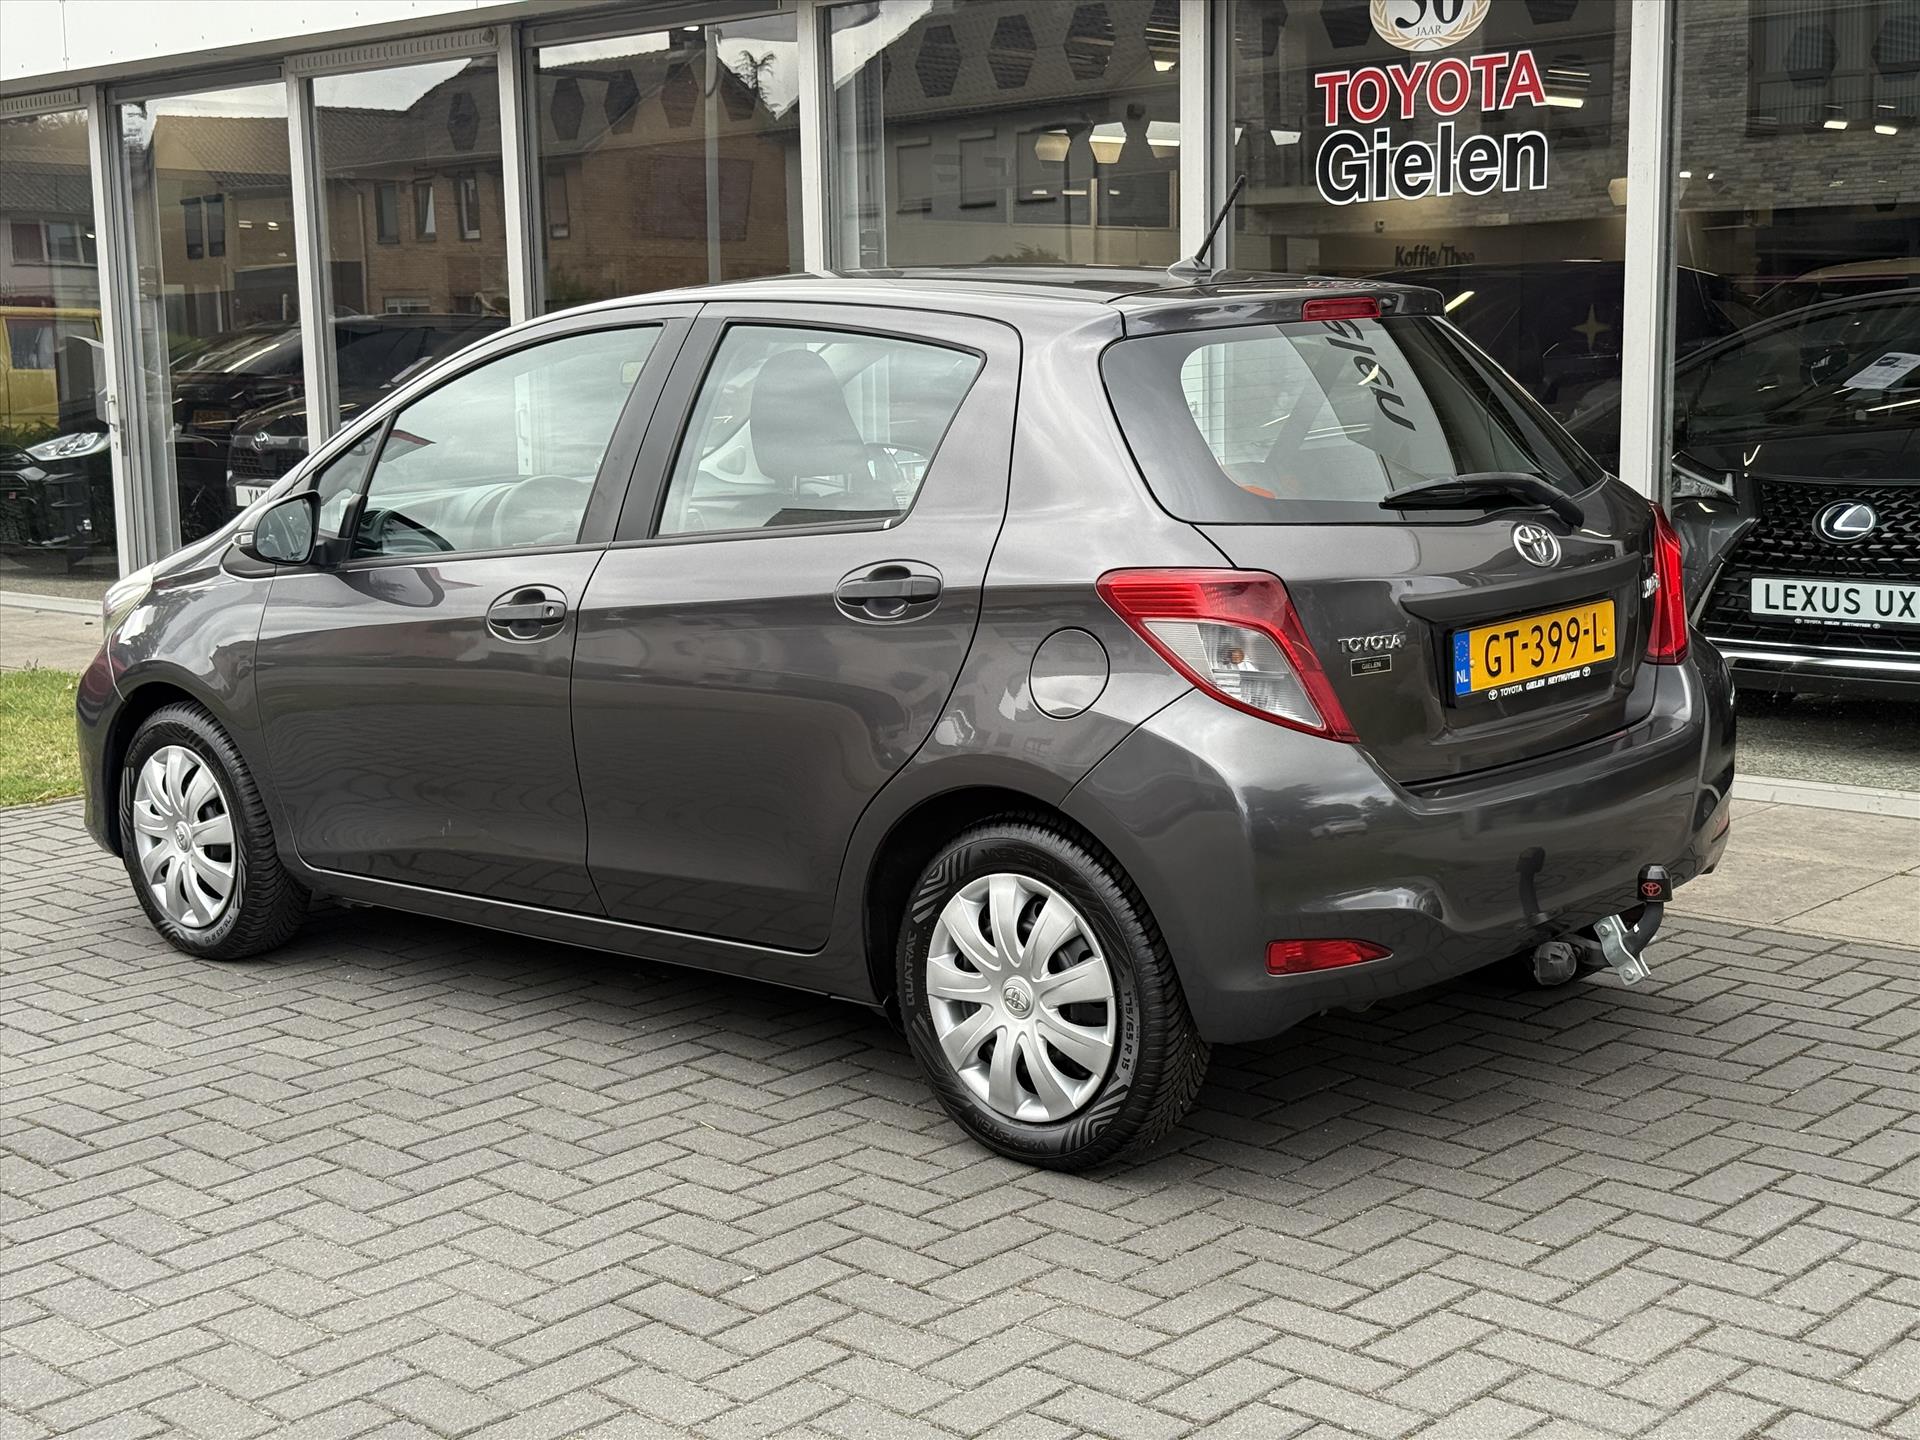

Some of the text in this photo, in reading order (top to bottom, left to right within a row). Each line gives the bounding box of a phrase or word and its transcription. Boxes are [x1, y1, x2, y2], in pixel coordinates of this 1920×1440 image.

[1416, 25, 1442, 36] JAAR
[1314, 49, 1547, 126] TOYOTA
[1315, 121, 1548, 205] Gielen
[1765, 583, 1917, 618] LEXUS UX
[1337, 634, 1403, 653] TOYOTA
[1484, 612, 1606, 678] GT-399-L
[1456, 670, 1469, 684] NL
[1500, 685, 1523, 697] TOYOTA
[904, 930, 918, 1007] QUATRAC
[1123, 990, 1135, 1041] 175/65
[1124, 1043, 1134, 1055] R
[1121, 1057, 1131, 1071] 15
